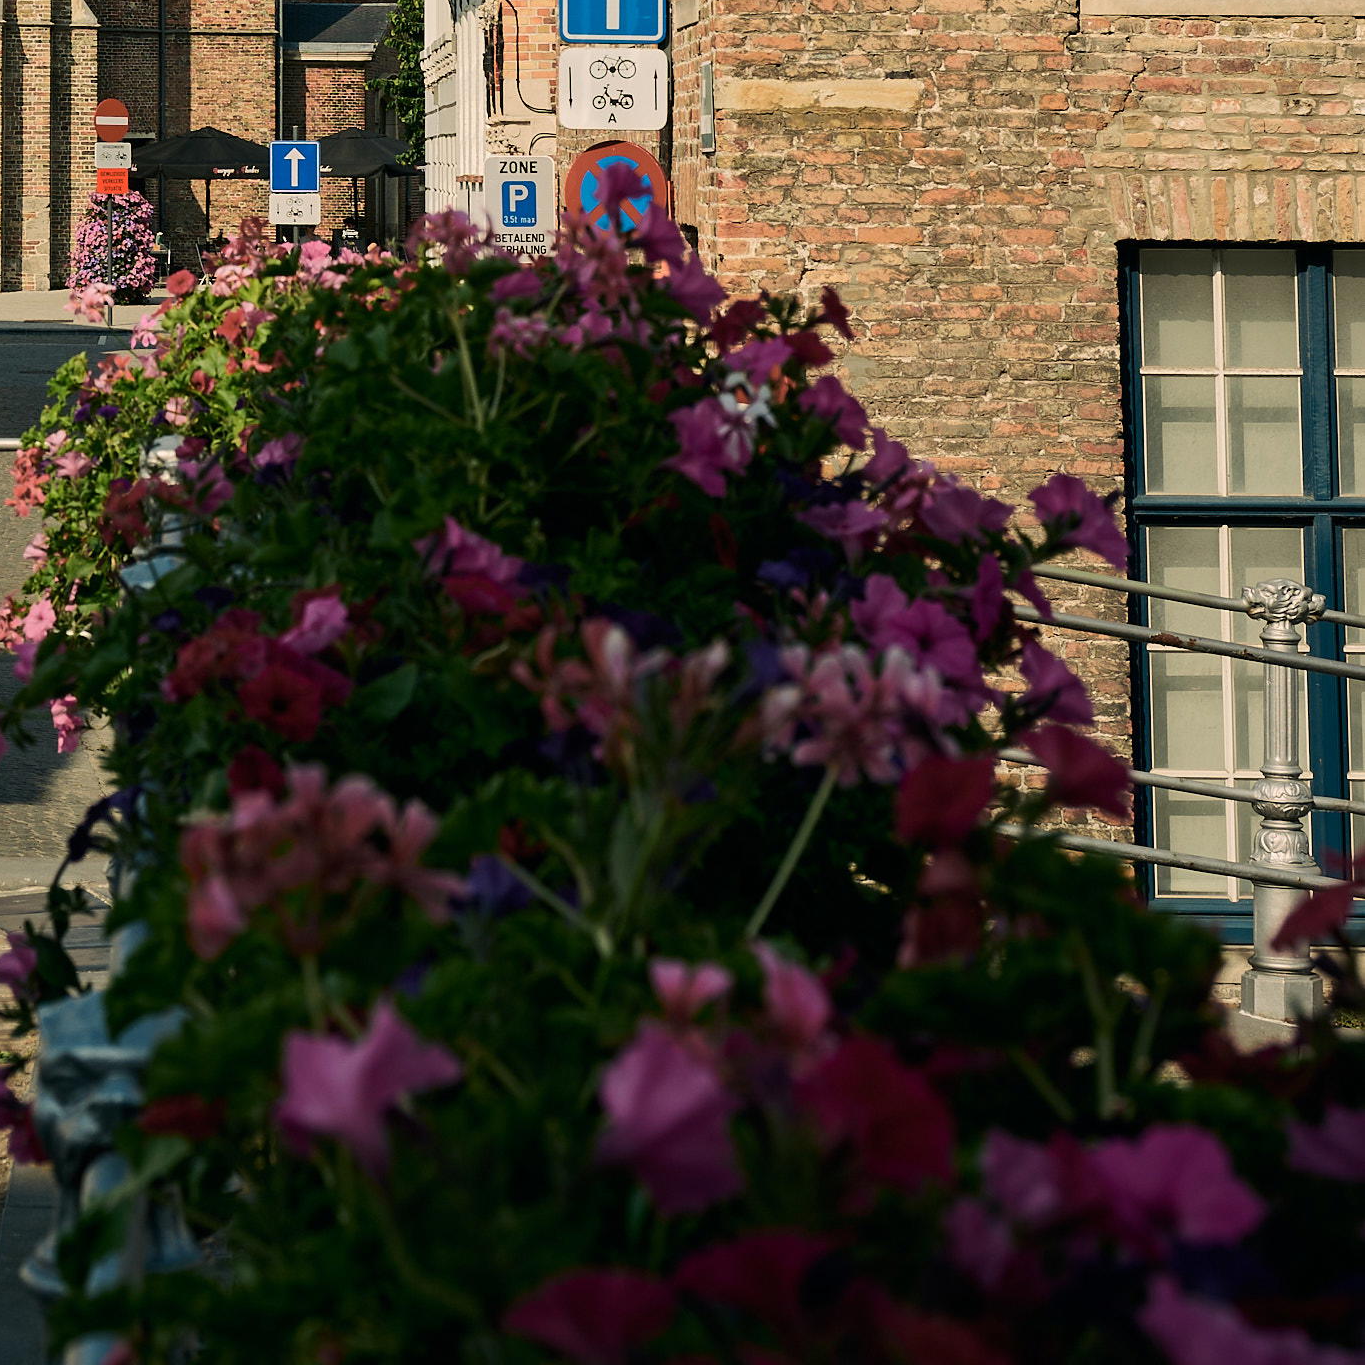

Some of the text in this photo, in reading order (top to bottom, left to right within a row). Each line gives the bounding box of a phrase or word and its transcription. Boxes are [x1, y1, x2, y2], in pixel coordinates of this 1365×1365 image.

[608, 113, 617, 123] A
[499, 161, 538, 174] ZONE
[509, 184, 529, 212] P
[495, 233, 545, 243] BETALEND
